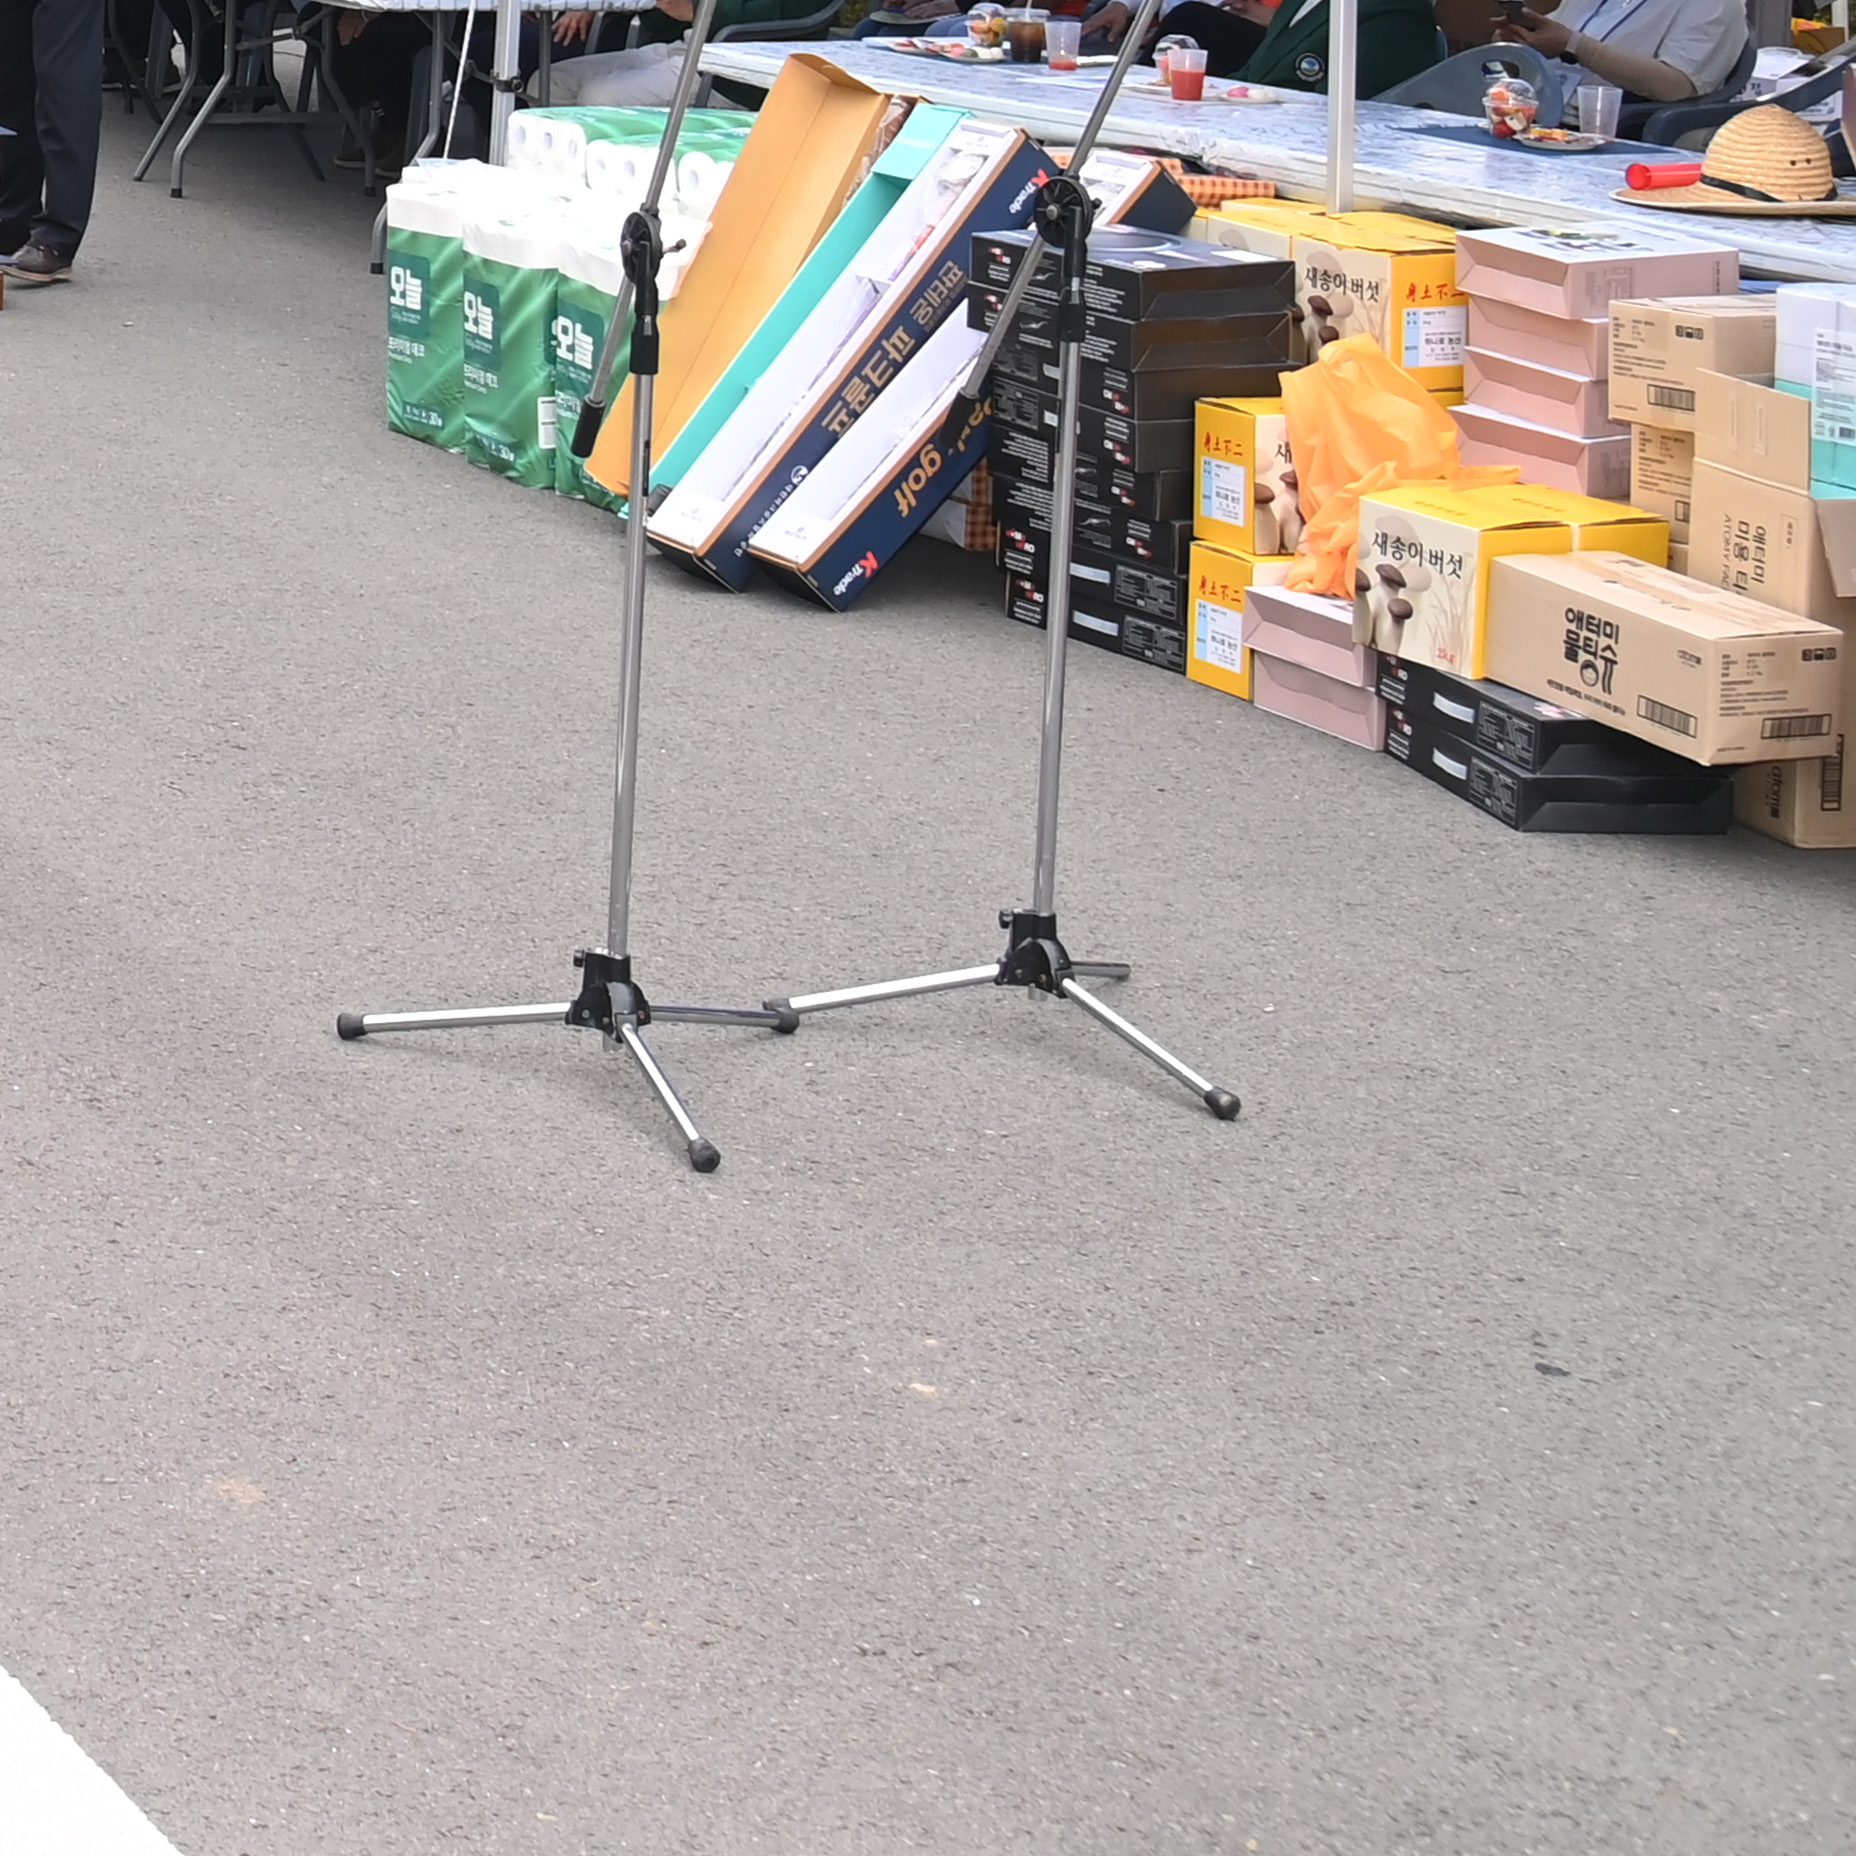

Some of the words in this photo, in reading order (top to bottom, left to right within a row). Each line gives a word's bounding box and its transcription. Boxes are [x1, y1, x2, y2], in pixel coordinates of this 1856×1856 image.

[390, 266, 423, 311] 오늘
[464, 291, 494, 340] 오늘
[910, 260, 967, 326] 판테온
[556, 315, 594, 370] 오늘
[821, 326, 916, 436] 파크골프
[893, 443, 943, 518] golf
[1731, 569, 1749, 594] 티
[1750, 525, 1767, 584] 애터미
[1565, 607, 1620, 644] 애터미
[1563, 628, 1619, 695] 물티슈
